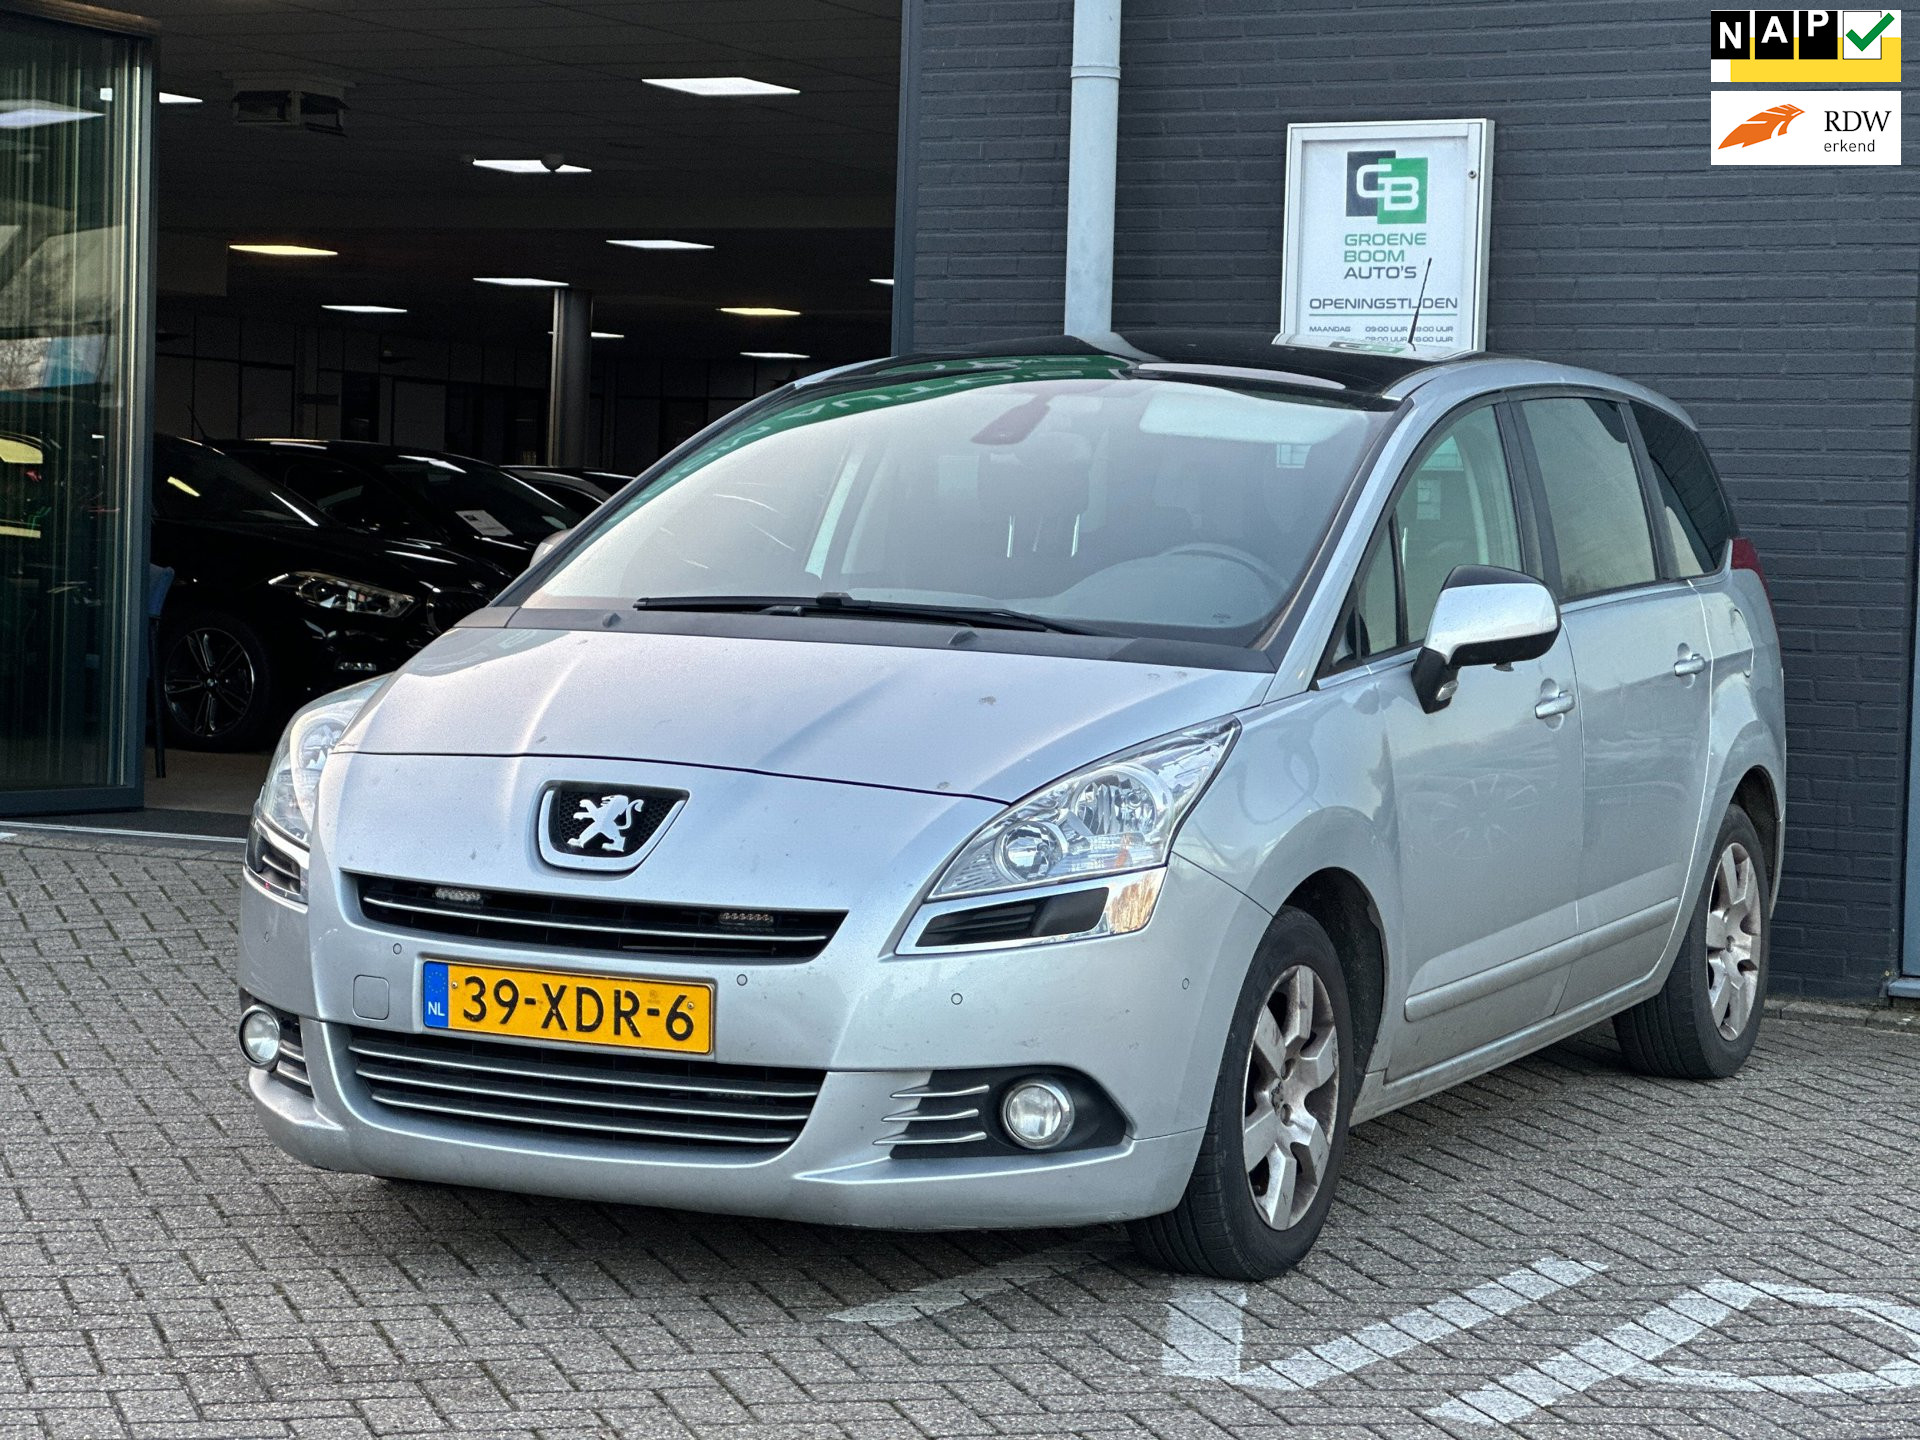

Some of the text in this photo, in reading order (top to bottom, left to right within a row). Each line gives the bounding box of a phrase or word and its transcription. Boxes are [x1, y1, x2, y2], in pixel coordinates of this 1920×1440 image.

[1344, 232, 1427, 246] GROENE
[1344, 249, 1405, 263] BOOM
[1344, 266, 1417, 279] AUTO'S
[1309, 325, 1454, 333] MAANDAG 09:00 UUR 8:00 UUR
[1435, 335, 1453, 343] UUR
[427, 1001, 445, 1017] NL
[463, 976, 695, 1041] 39-XDR-6
